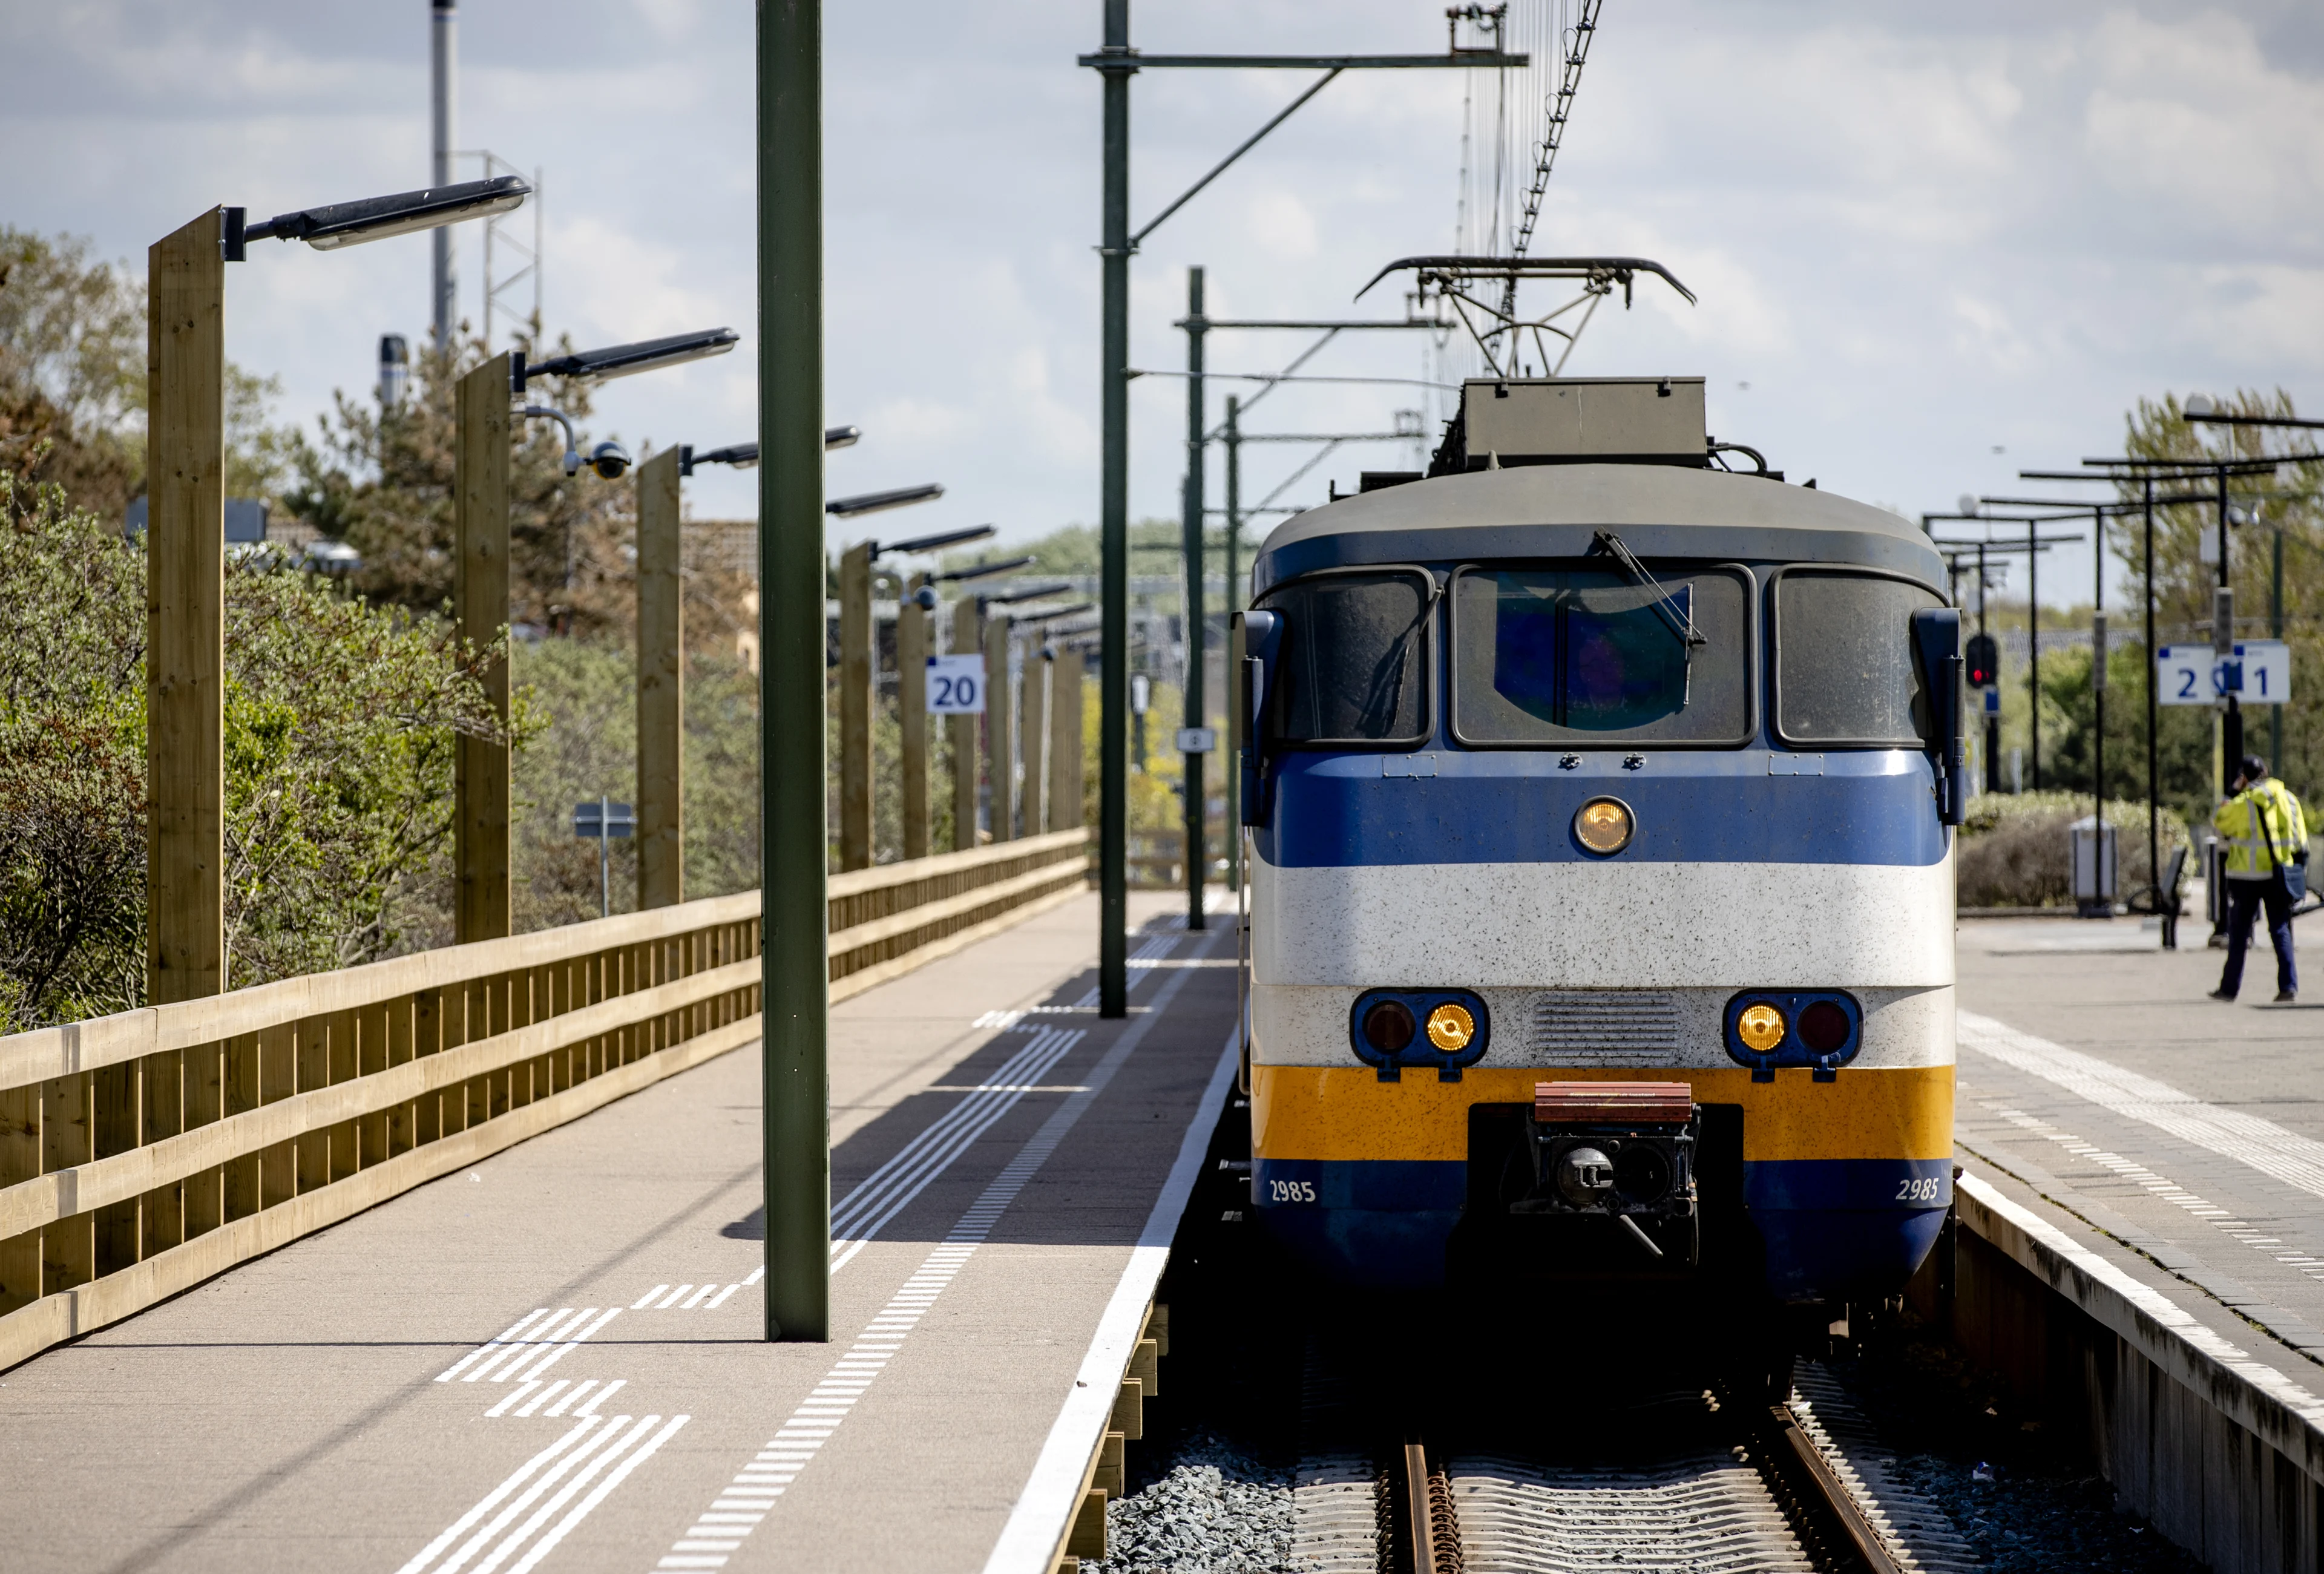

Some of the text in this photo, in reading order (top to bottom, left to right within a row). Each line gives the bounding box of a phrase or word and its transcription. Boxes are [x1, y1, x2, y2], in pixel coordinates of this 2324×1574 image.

[933, 675, 975, 707] 20
[2178, 667, 2197, 698] 2
[2254, 666, 2268, 697] 1
[1270, 1179, 1316, 1202] 2985
[1896, 1178, 1939, 1201] 2985
